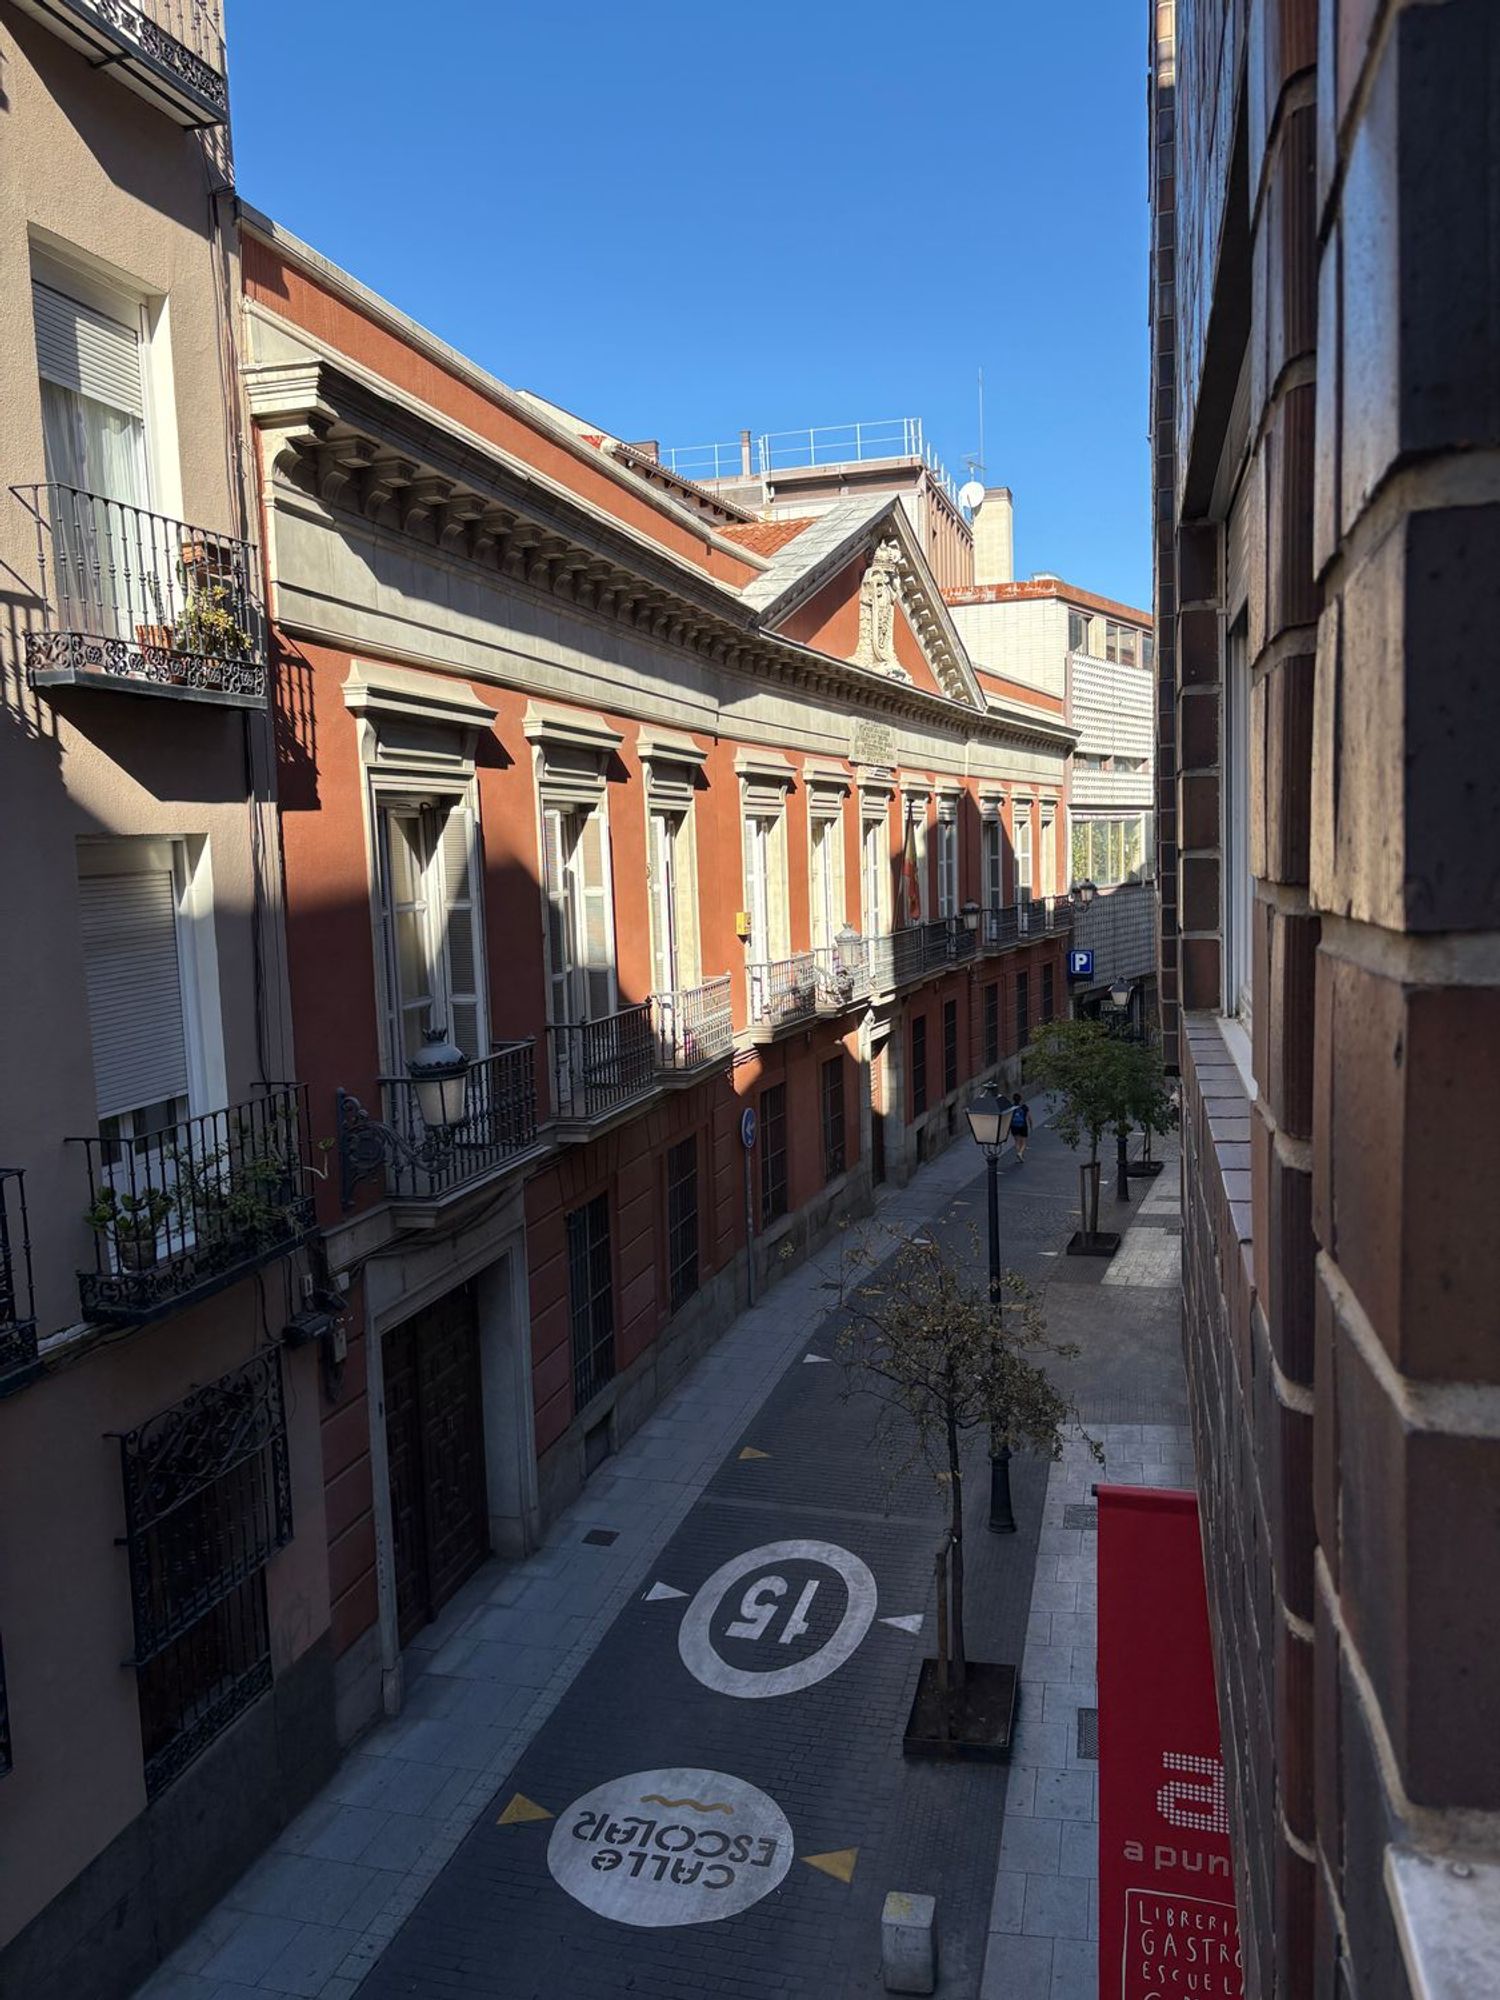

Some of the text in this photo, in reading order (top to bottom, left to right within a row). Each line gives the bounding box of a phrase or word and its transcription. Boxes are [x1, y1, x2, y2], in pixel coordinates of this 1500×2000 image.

[1074, 953, 1088, 971] P
[725, 1575, 820, 1644] 15
[572, 1811, 778, 1868] ESCOLAR
[1142, 1961, 1244, 1996] ESCUEL
